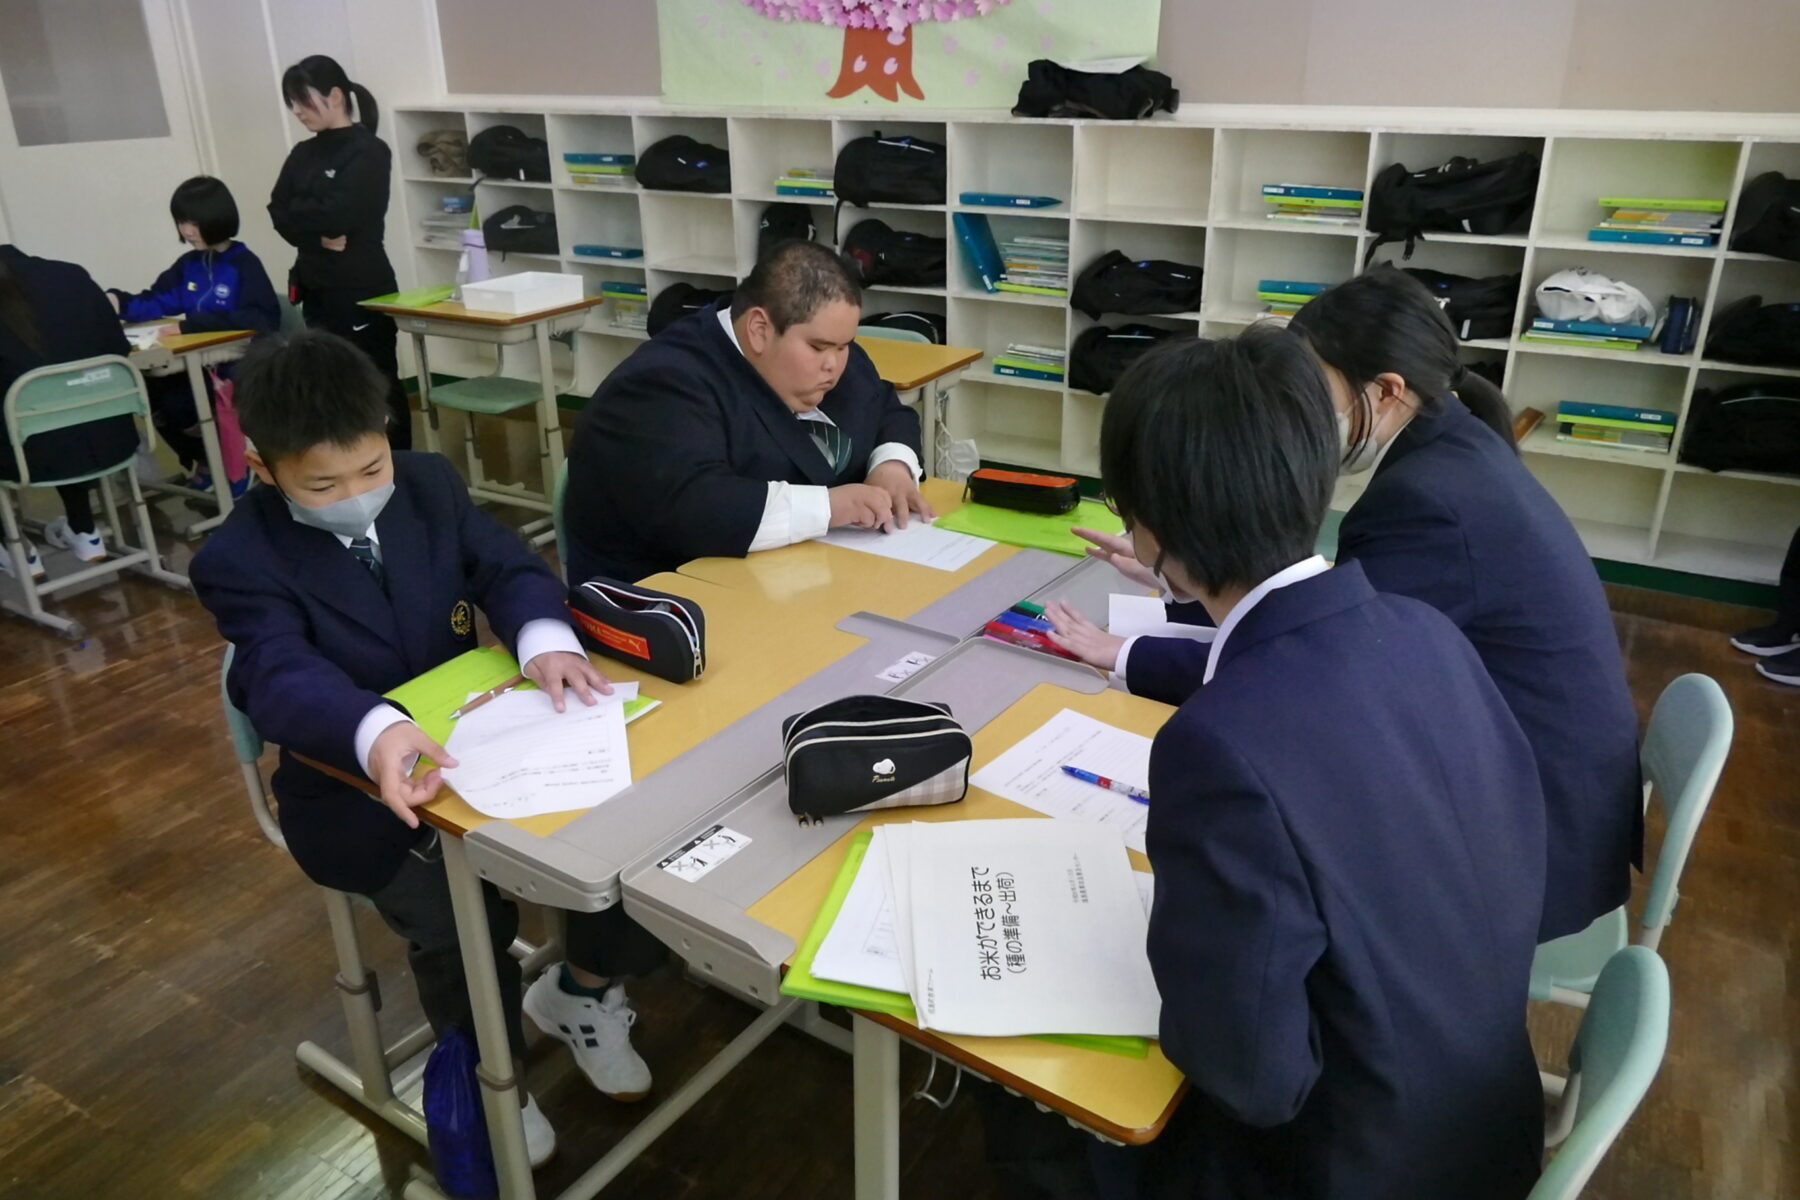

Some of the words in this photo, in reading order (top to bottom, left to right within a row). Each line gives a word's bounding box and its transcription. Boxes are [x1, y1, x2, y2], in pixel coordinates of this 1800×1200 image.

[971, 866, 1002, 981] お米ができるまで
